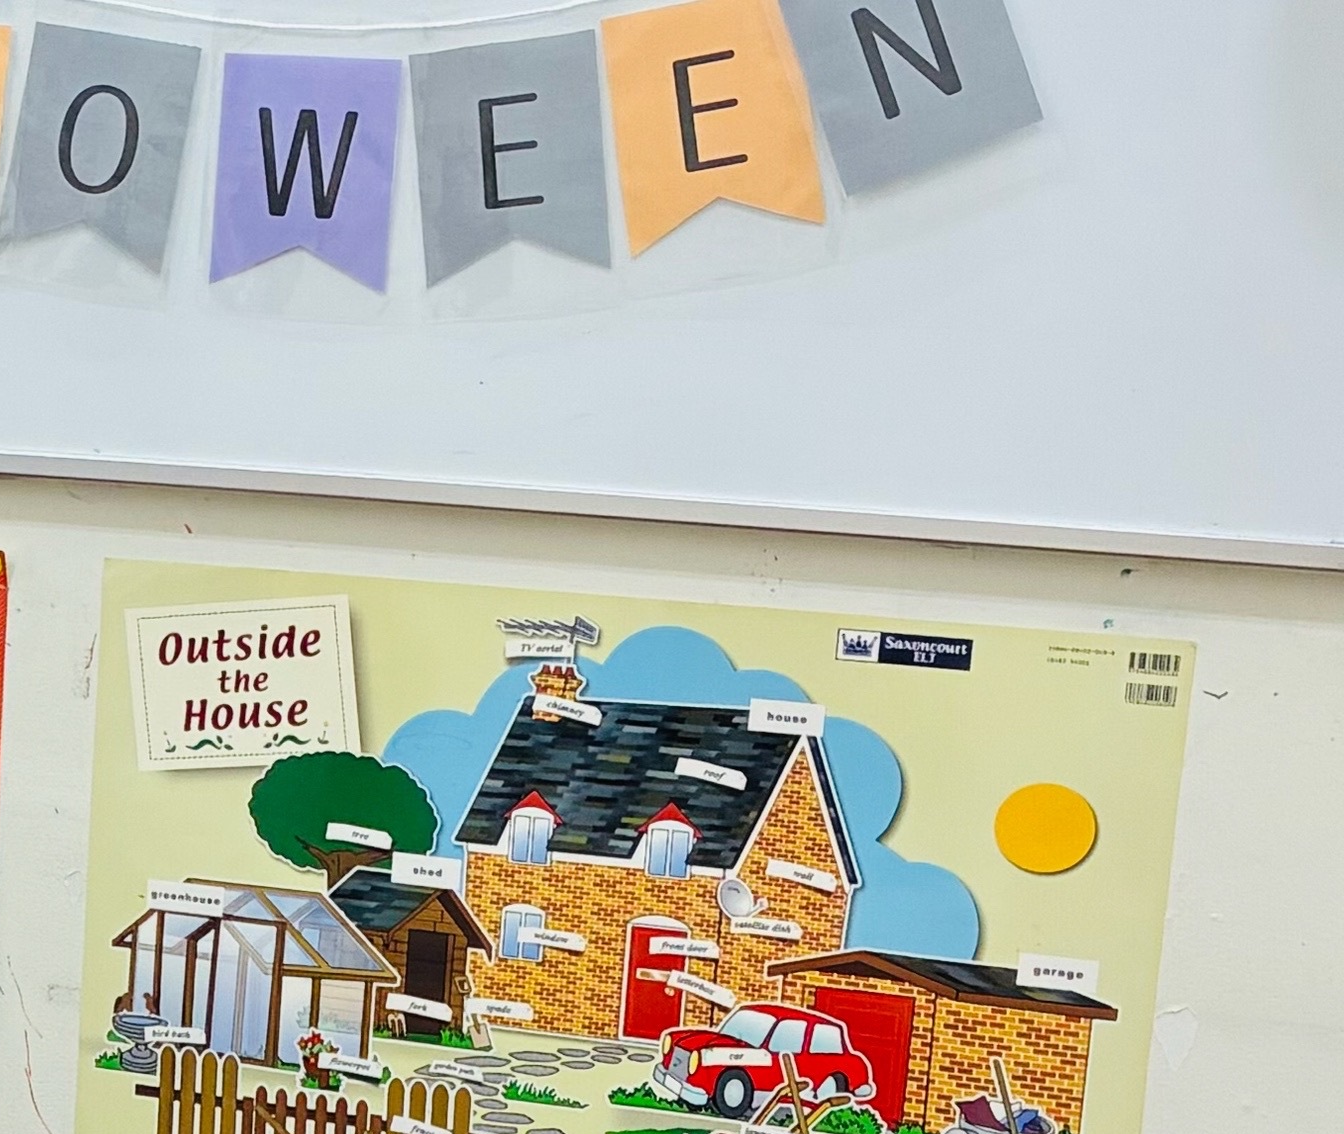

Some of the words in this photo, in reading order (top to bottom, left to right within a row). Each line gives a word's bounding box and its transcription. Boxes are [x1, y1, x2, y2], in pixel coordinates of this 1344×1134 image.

[158, 623, 322, 666] Outside
[884, 635, 968, 656] Saxoncourt
[217, 669, 269, 694] the
[183, 697, 309, 732] House
[766, 711, 808, 725] house
[412, 865, 443, 878] shed
[150, 888, 222, 908] greenhouse
[1032, 966, 1085, 981] garage
[728, 1052, 744, 1061] car
